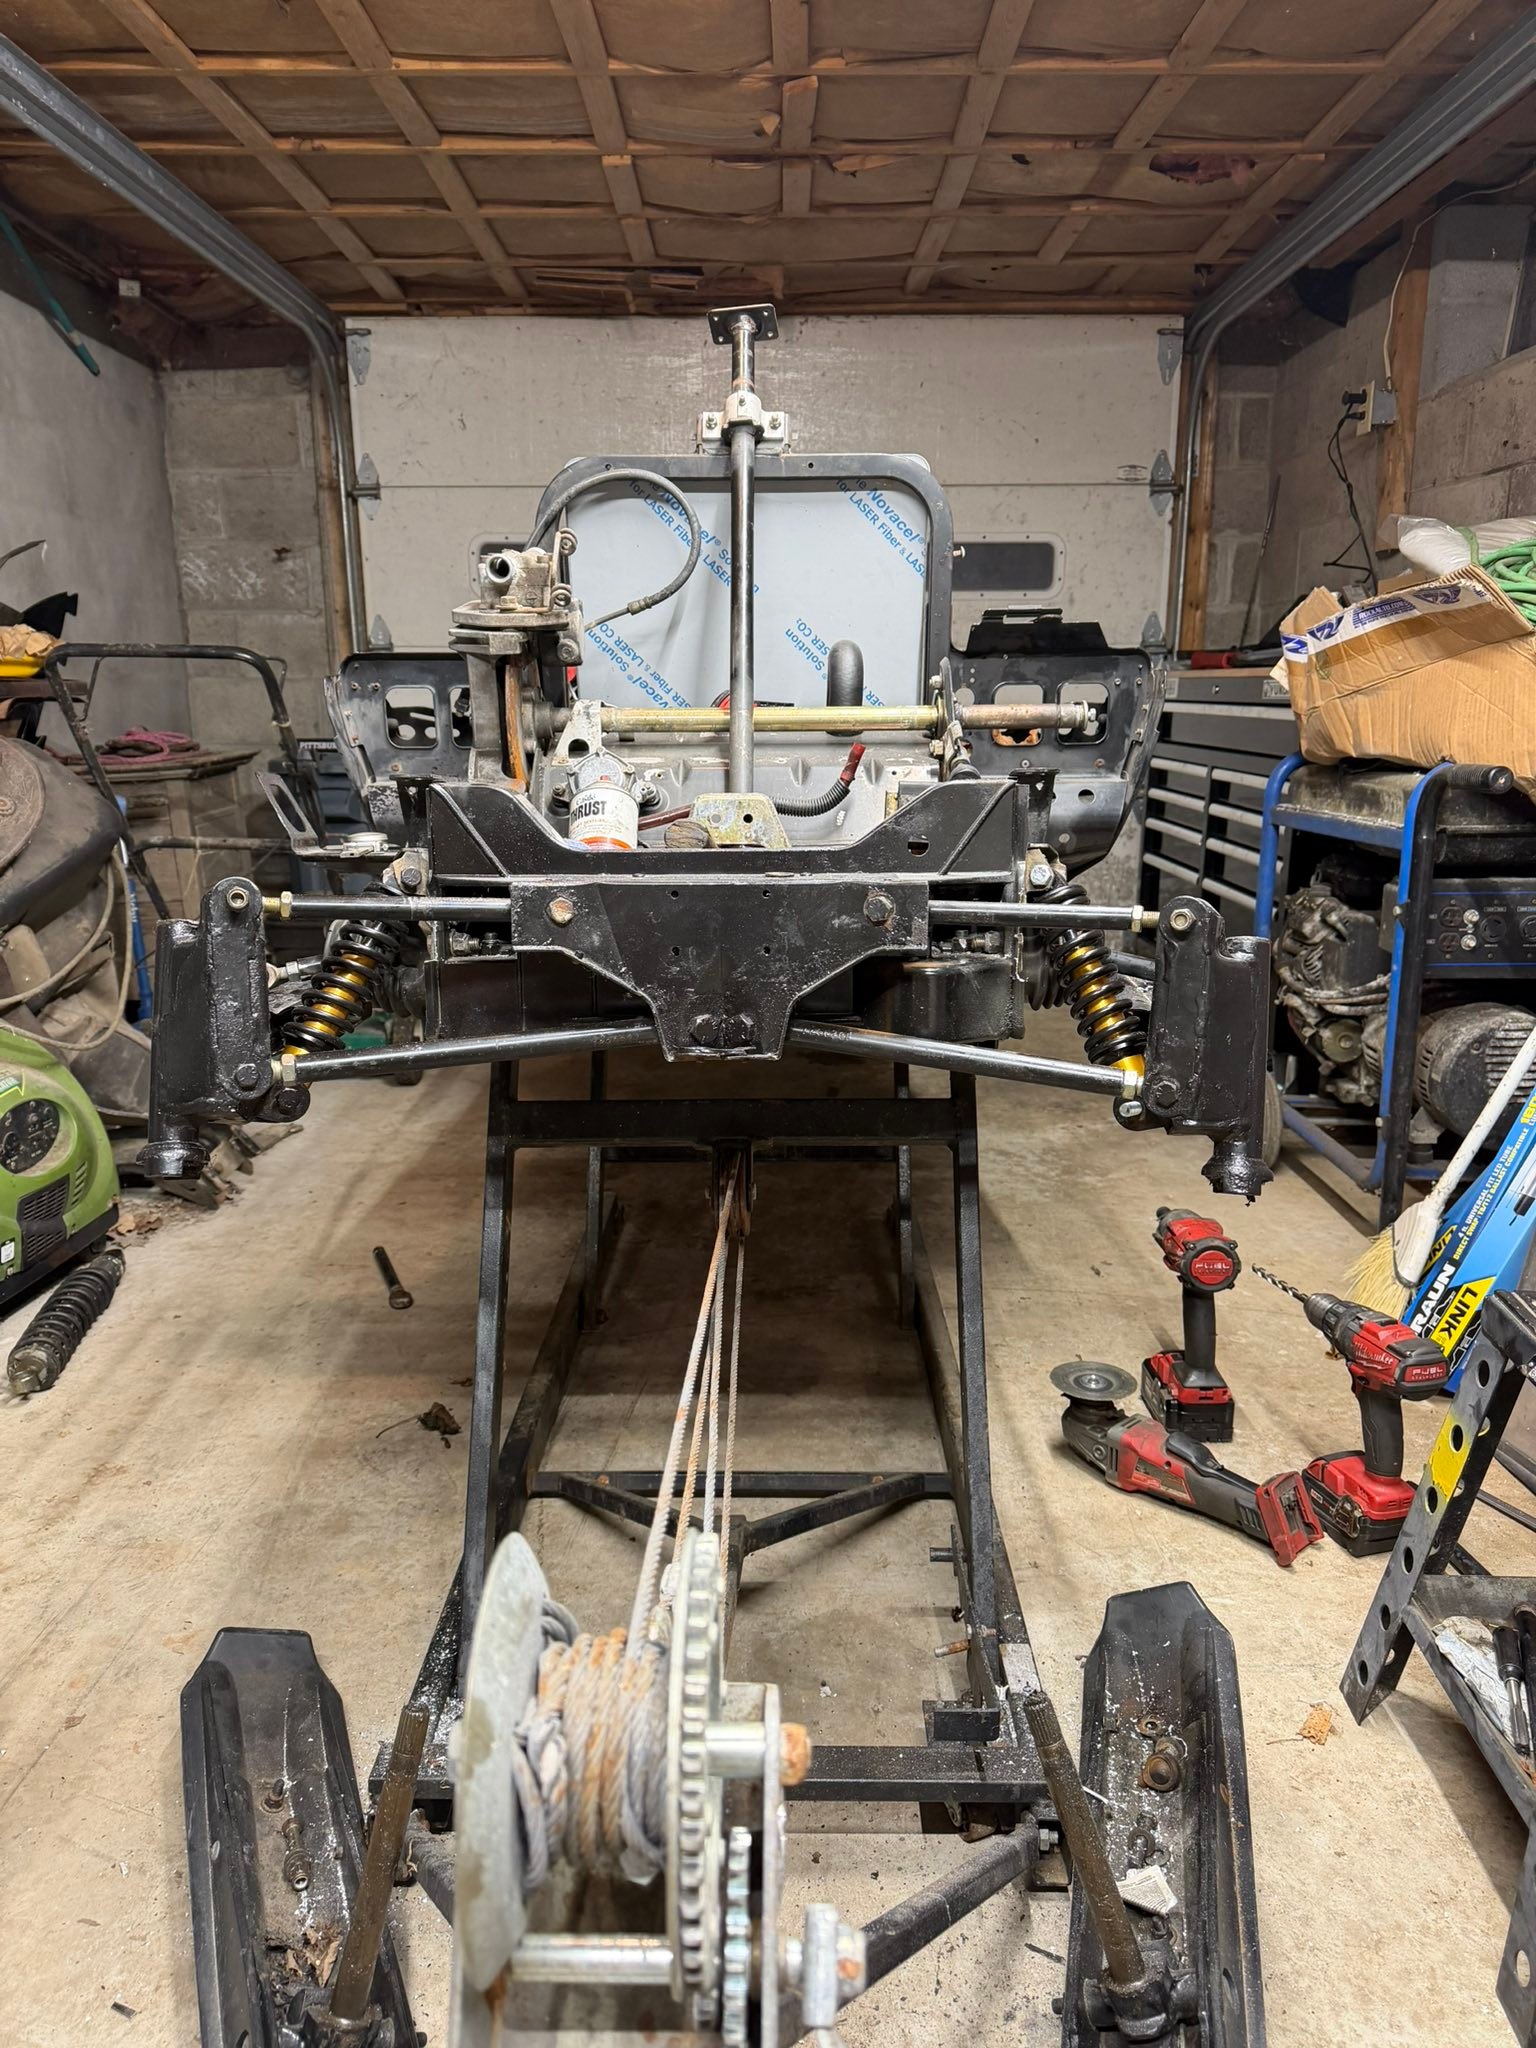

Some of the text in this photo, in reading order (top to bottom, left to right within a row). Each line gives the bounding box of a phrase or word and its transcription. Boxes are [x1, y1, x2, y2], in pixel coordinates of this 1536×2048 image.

[643, 494, 675, 527] LASER
[673, 524, 694, 548] Fibe
[661, 491, 722, 546] Novel®
[836, 479, 850, 493] for
[849, 492, 880, 525] LASER
[877, 522, 902, 548] Fiber
[586, 629, 631, 673] Solution
[614, 636, 645, 667] LASER
[785, 627, 826, 672] Solution
[811, 635, 831, 656] SER
[649, 671, 674, 695] Fiber
[672, 692, 692, 708] SER
[1452, 1235, 1470, 1260] DIRECT
[1466, 1217, 1479, 1237] SWAP
[1489, 1167, 1507, 1194] BALLAST
[1504, 1127, 1530, 1167] COMPATIBLE
[1465, 1188, 1489, 1224] UNIVERSAL
[1485, 1175, 1496, 1188] FIT
[1492, 1162, 1503, 1177] LED
[1499, 1145, 1513, 1162] TUBE
[1409, 1262, 1456, 1334] RAUN
[1439, 1286, 1479, 1340] LINK
[1412, 1366, 1443, 1376] FUEL
